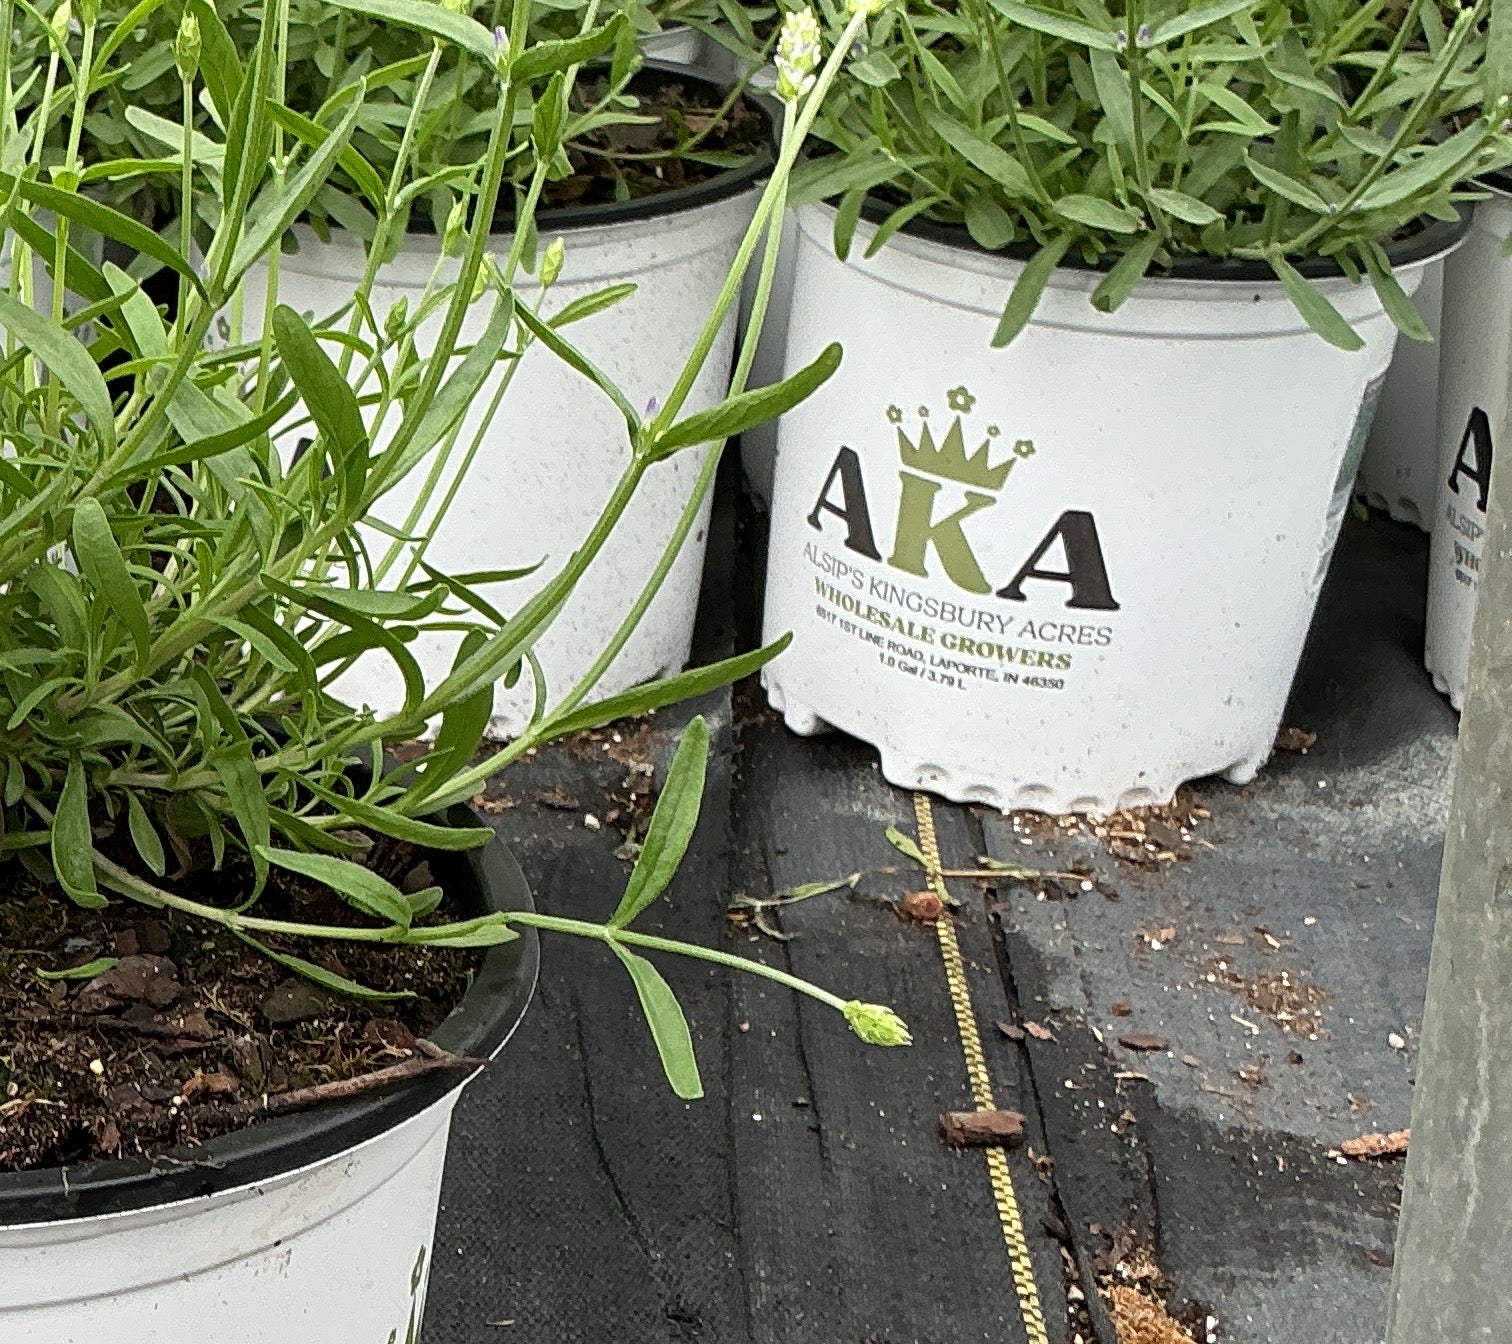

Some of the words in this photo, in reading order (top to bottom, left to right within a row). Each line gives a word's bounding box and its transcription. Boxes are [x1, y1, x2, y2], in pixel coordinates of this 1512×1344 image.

[807, 445, 1120, 612] AKA
[803, 541, 864, 590] ALSIP'S
[870, 576, 1015, 635] KINGSBURY
[1017, 619, 1113, 647] ACRES
[814, 575, 936, 646] WHOLESALE
[940, 632, 1072, 670] GROWERS
[879, 652, 895, 668] 1.0
[898, 660, 919, 676] Gal
[957, 678, 967, 691] L
[1003, 672, 1019, 684] IN
